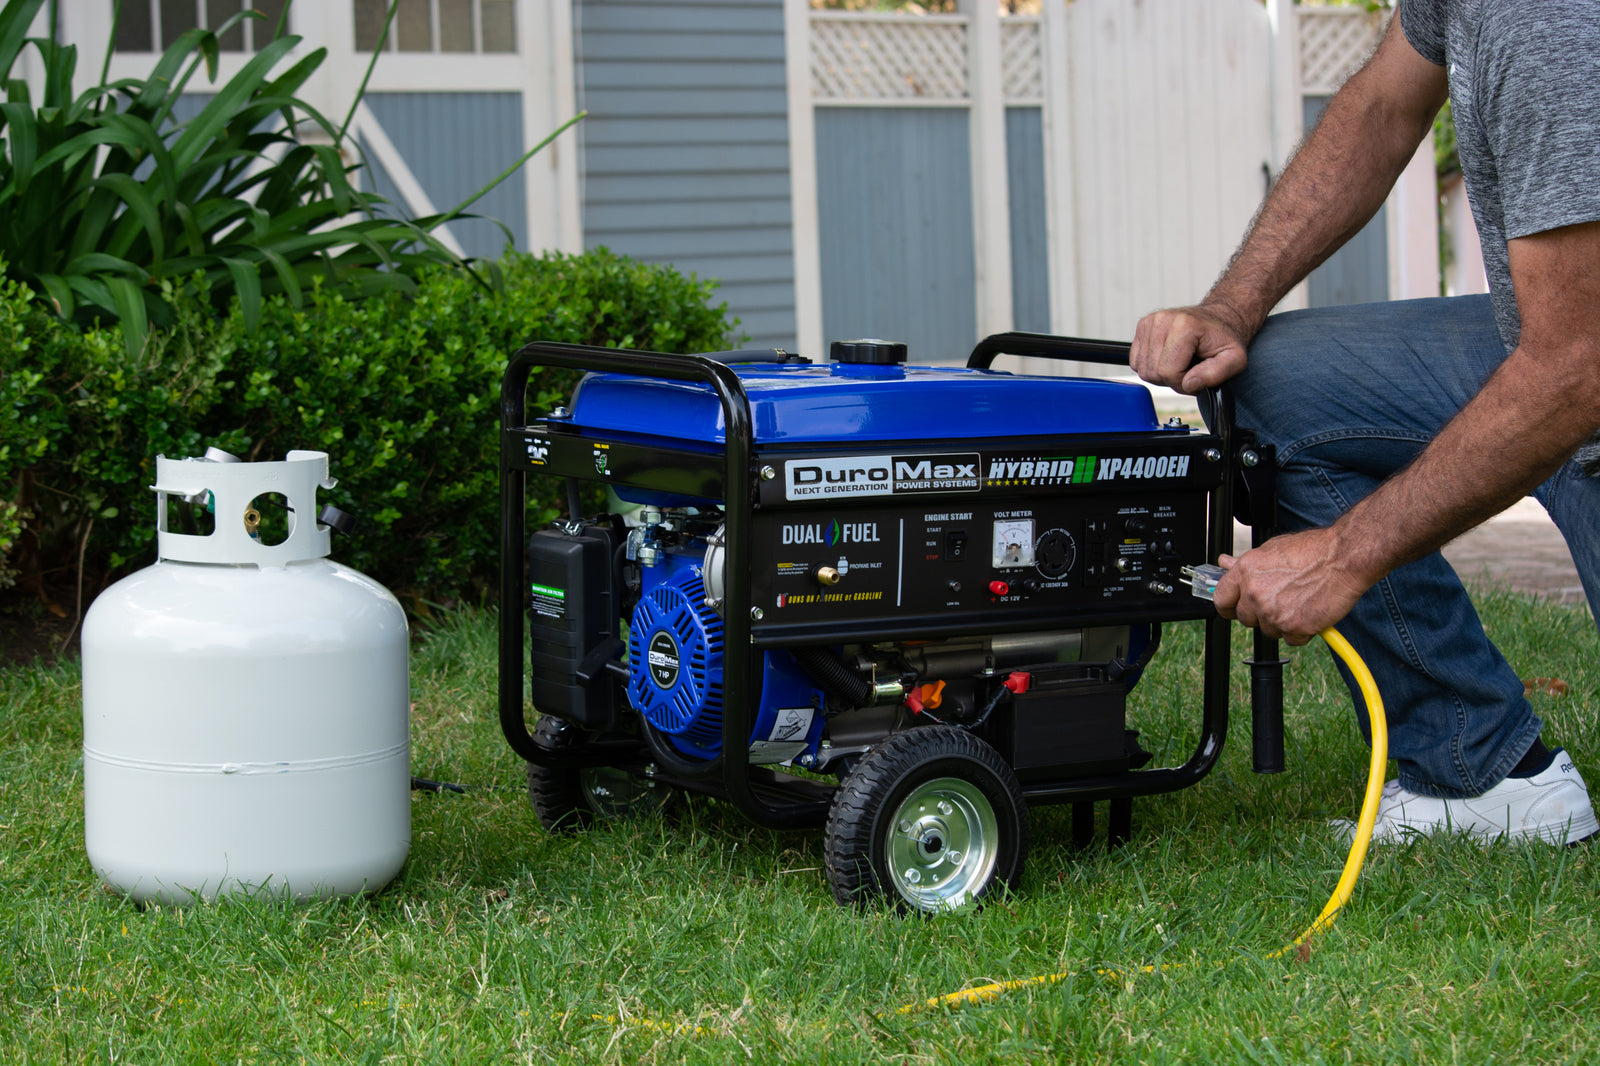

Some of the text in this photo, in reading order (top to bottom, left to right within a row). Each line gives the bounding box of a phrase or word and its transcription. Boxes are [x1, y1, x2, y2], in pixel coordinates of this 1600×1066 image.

[989, 460, 1074, 479] HYBRID
[1097, 455, 1190, 480] XP4400EH
[896, 479, 977, 490] POWER SYSTEMS
[1030, 477, 1071, 485] ELITE
[794, 483, 888, 496] NEXT GENERATION
[924, 512, 973, 521] ENGINE START
[782, 523, 880, 544] DUAL FUEL
[788, 595, 804, 604] RUNS
[806, 594, 815, 602] ON
[816, 593, 843, 602] POPANE
[854, 592, 882, 600] GASOLINE
